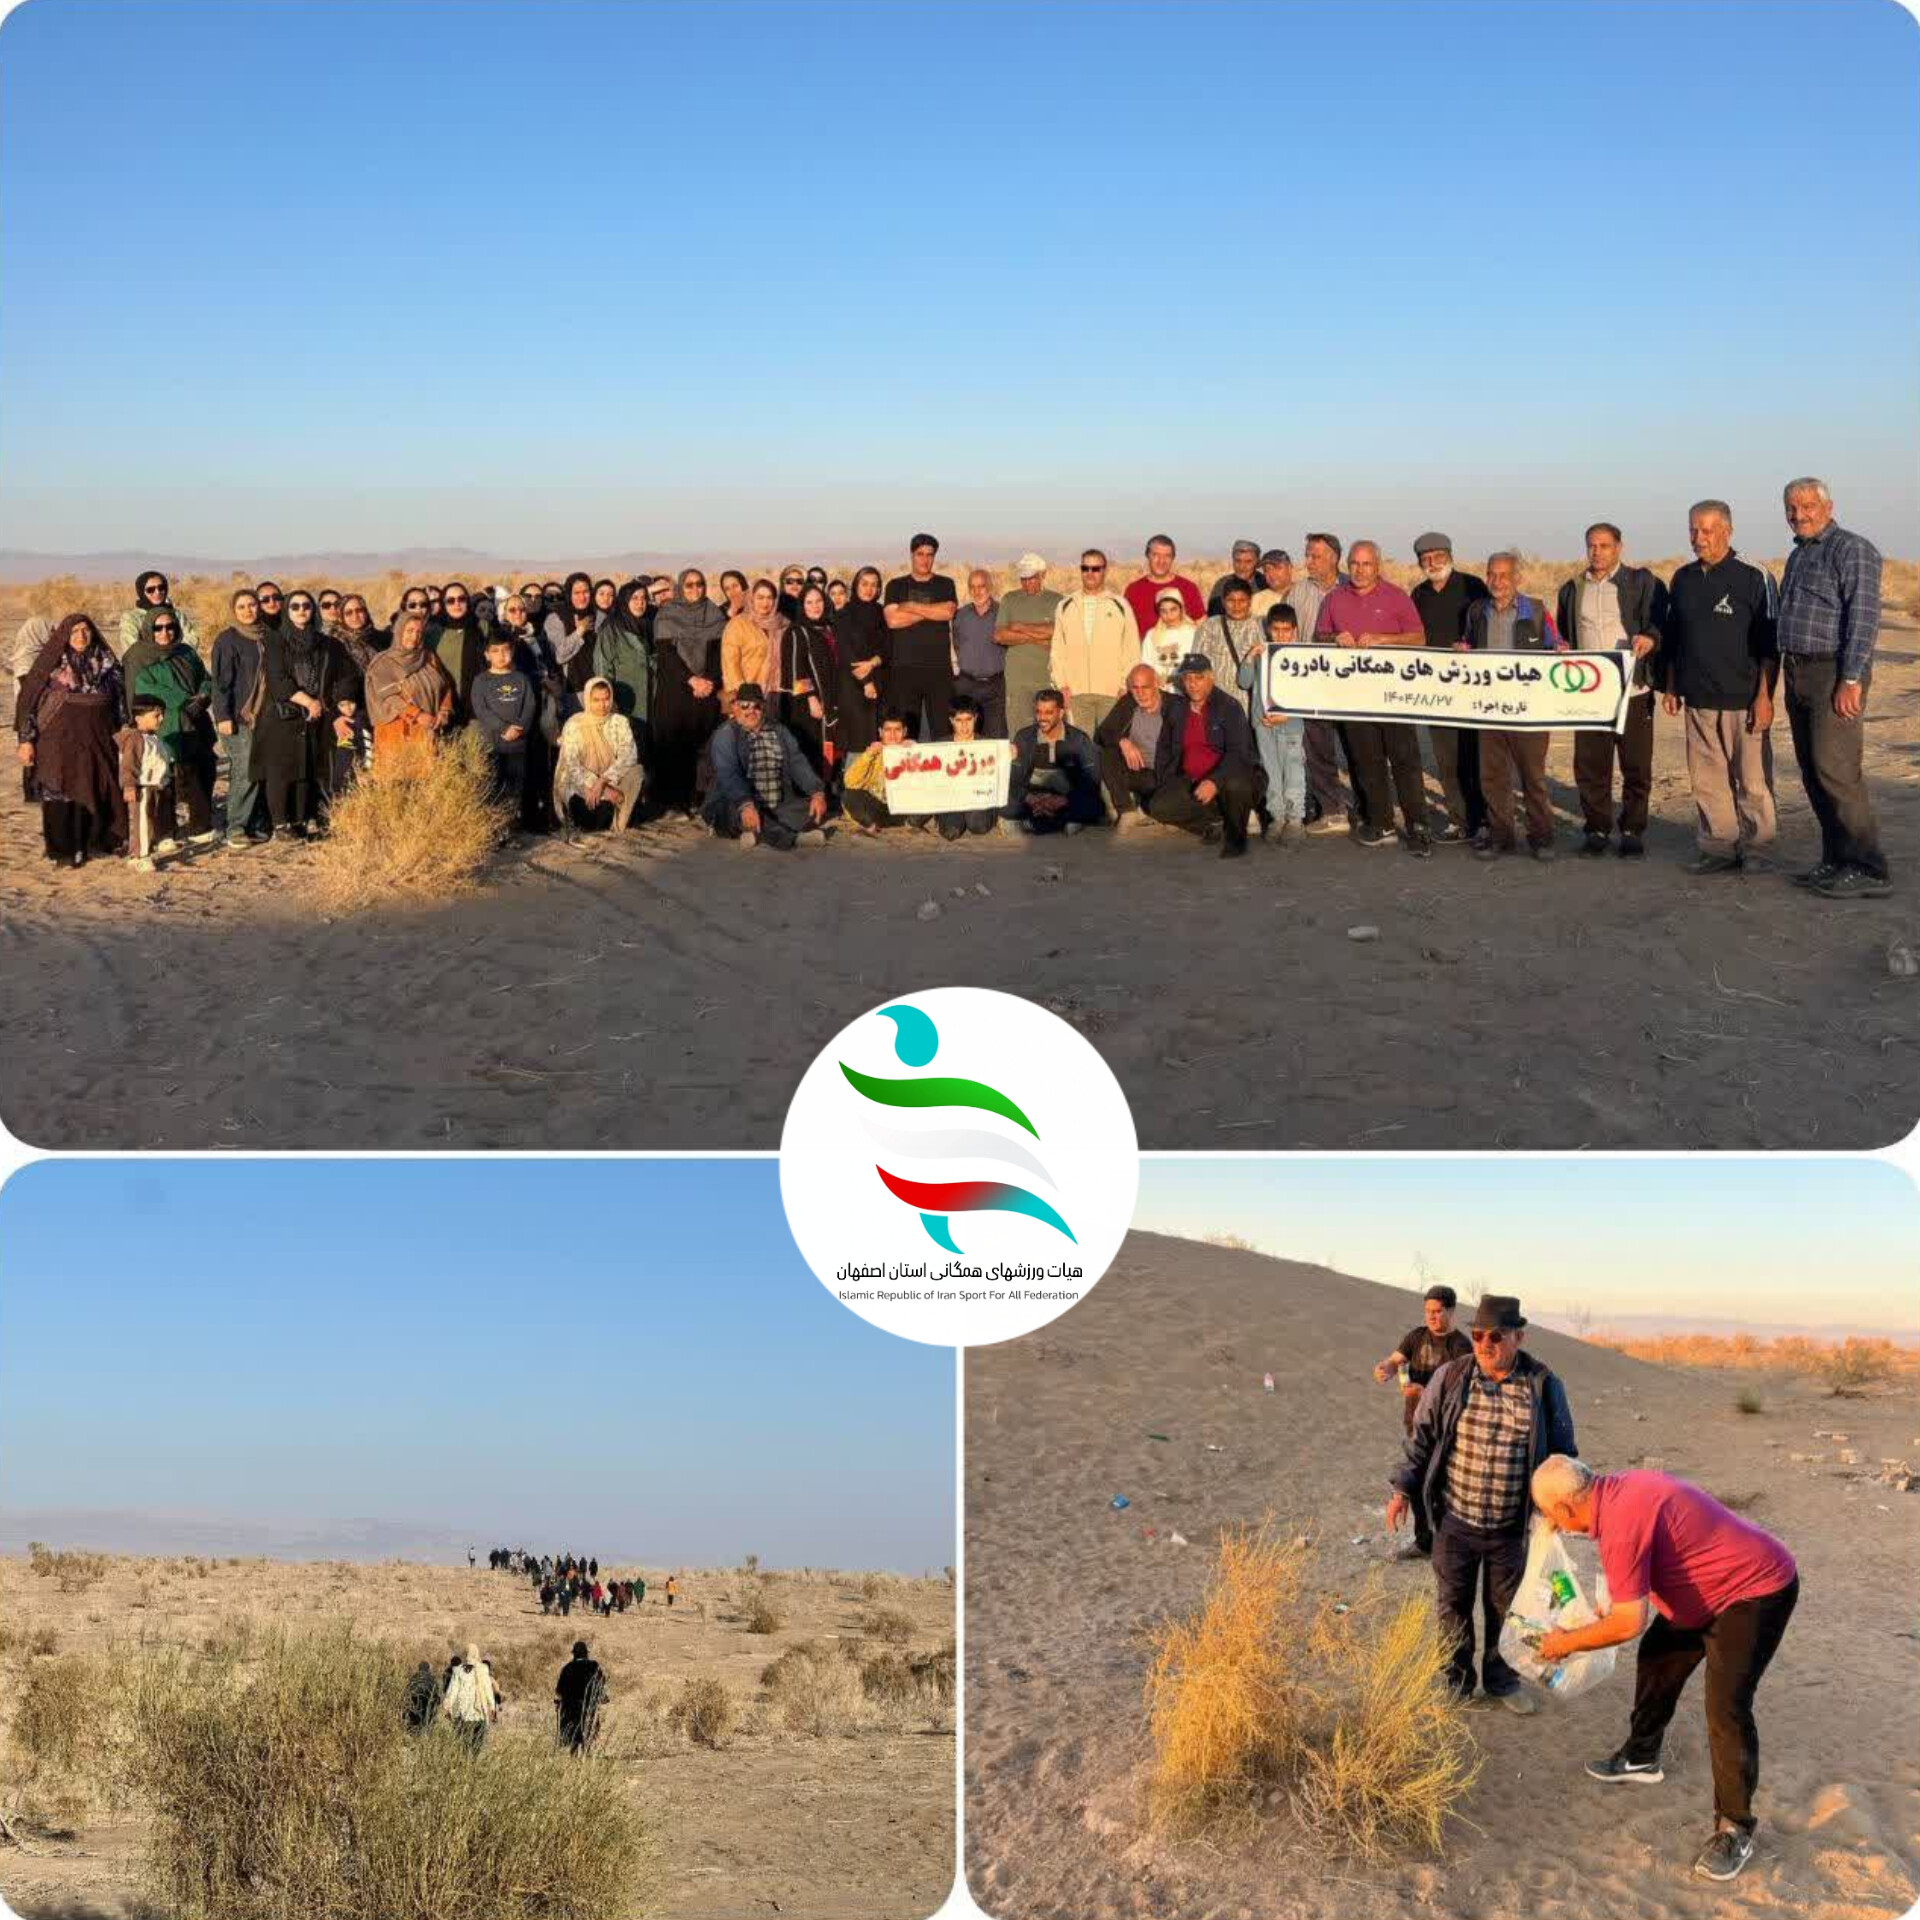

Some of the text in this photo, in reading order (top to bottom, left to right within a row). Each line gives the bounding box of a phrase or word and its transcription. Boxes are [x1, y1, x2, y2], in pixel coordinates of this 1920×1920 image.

[1280, 654, 1542, 686] هیات ورزش های همگانی بادرود
